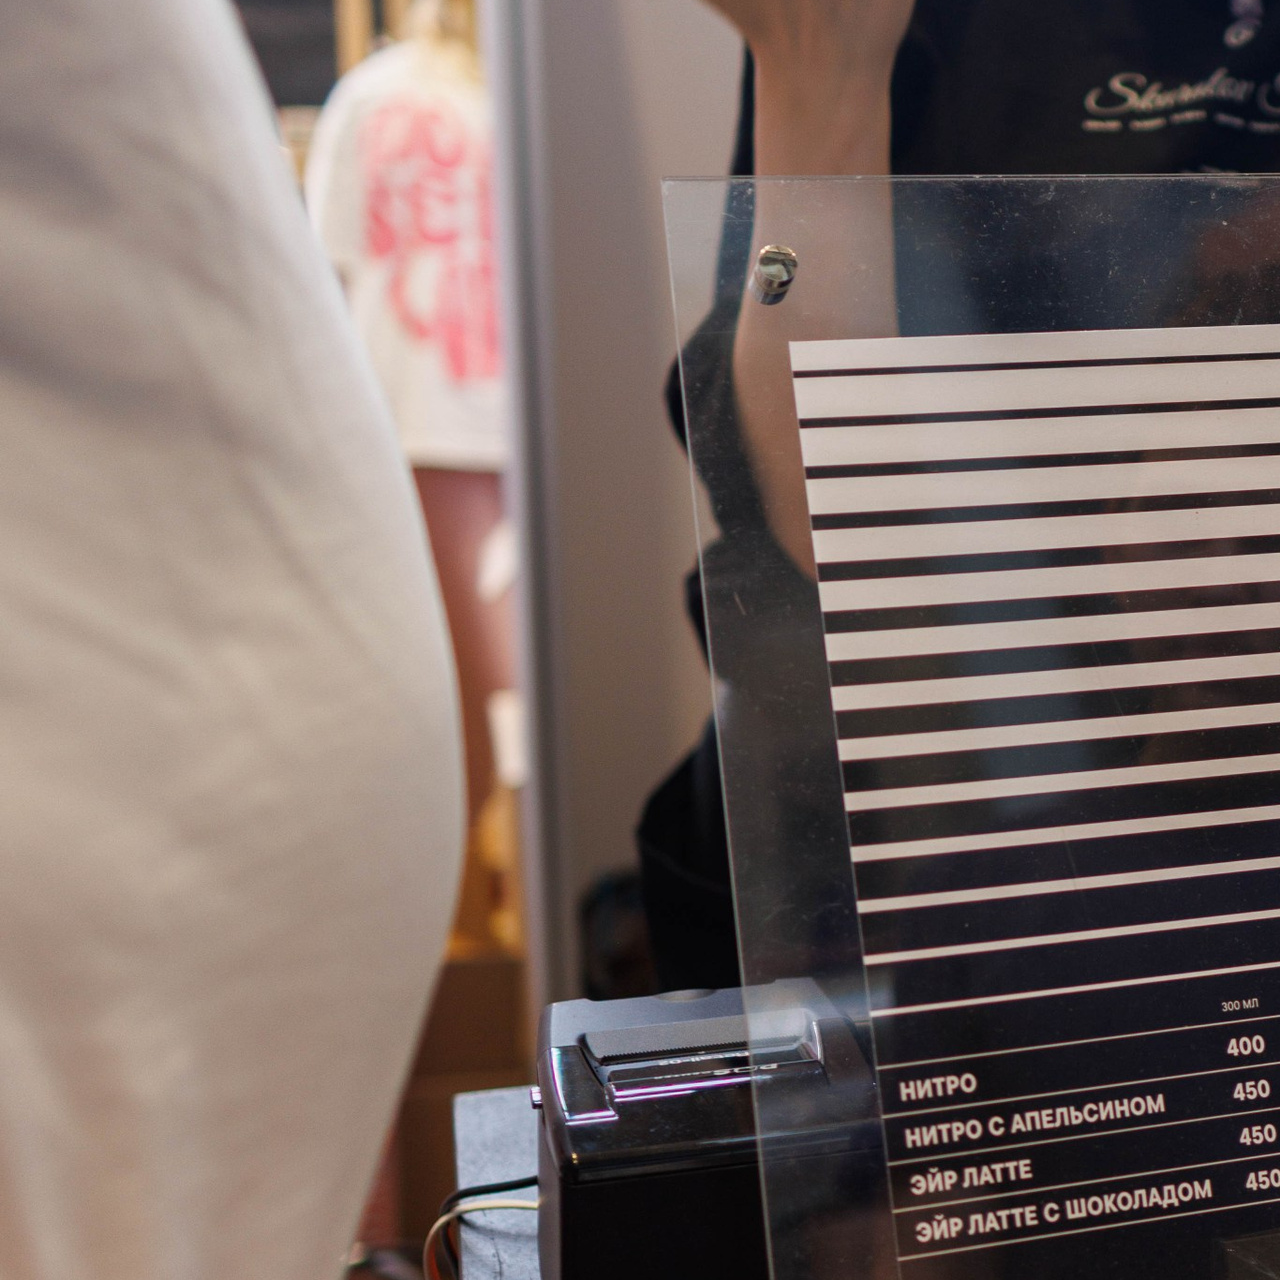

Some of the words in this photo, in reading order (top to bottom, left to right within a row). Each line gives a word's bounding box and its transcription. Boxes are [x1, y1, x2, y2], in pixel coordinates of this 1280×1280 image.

[1221, 1000, 1240, 1012] 300
[1242, 998, 1259, 1009] МЛ
[899, 1073, 977, 1101] НИТРО
[1227, 1035, 1265, 1056] 400
[905, 1119, 982, 1148] НИТРО
[988, 1116, 1005, 1136] С
[1011, 1093, 1166, 1134] АПЕЛЬСИНОМ
[1233, 1079, 1271, 1101] 450
[910, 1167, 957, 1195] ЭЙР
[963, 1159, 1033, 1188] ЛАТТЕ
[1239, 1124, 1277, 1145] 450
[915, 1214, 963, 1242] ЭЙР
[968, 1206, 1039, 1235] ЛАТТЕ
[1043, 1202, 1060, 1223] С
[1065, 1179, 1213, 1219] ШОКОЛАДОМ
